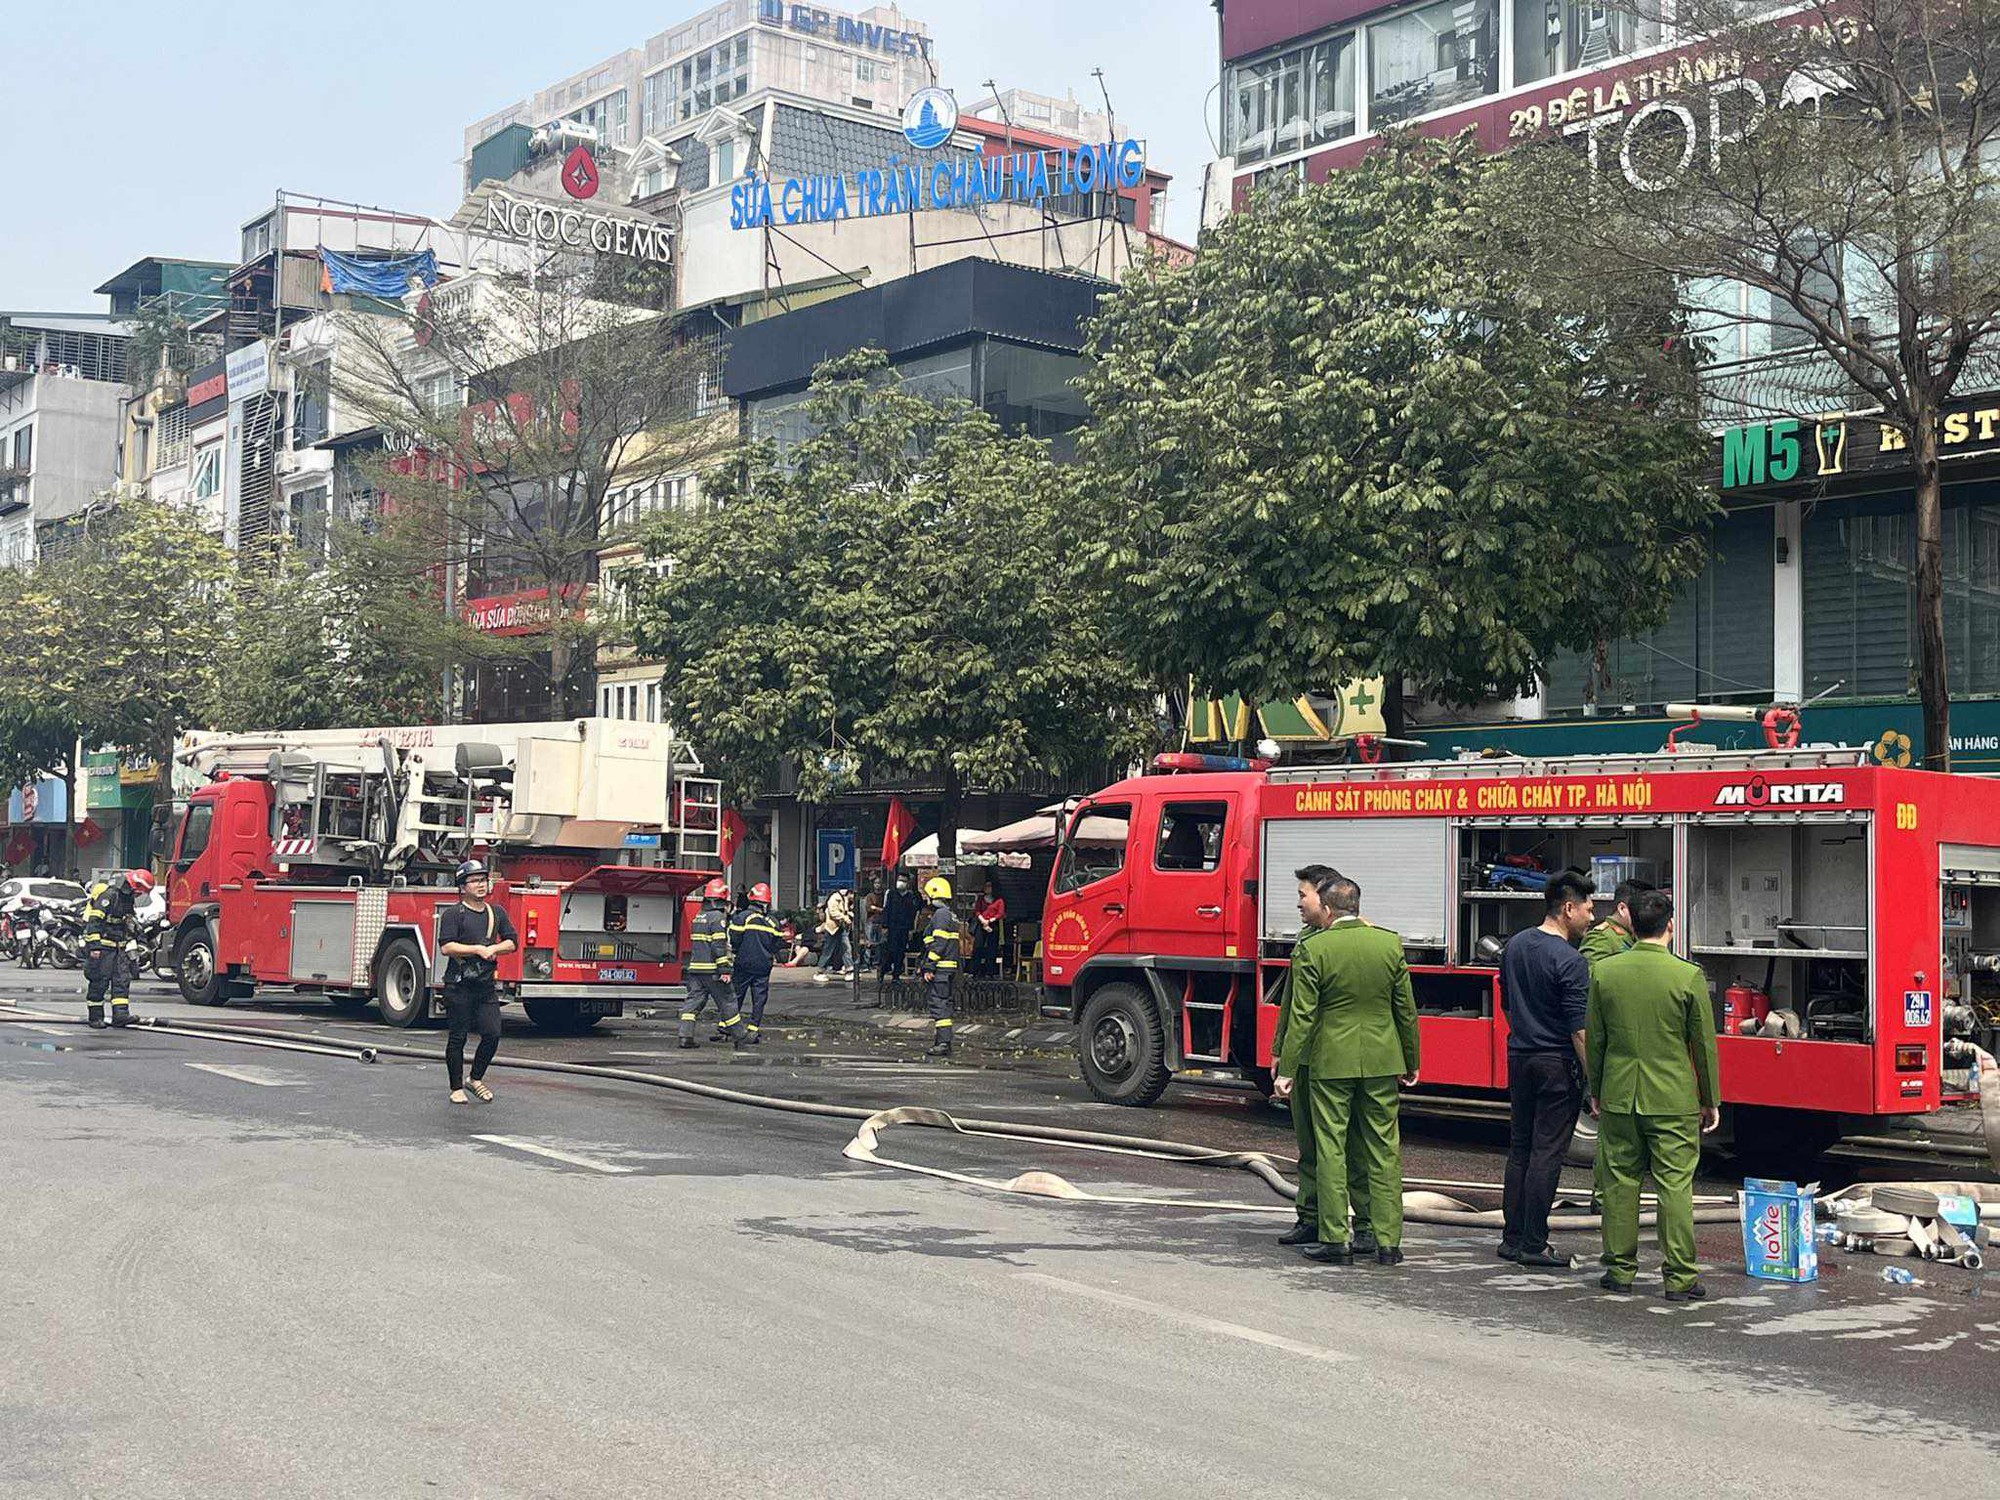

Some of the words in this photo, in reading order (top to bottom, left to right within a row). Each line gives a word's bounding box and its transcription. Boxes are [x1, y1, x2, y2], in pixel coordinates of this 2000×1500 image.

[791, 5, 831, 33] GP
[837, 16, 933, 57] INVEST
[1509, 106, 1543, 138] 29
[1593, 80, 1632, 114] LA
[730, 169, 775, 231] SỮA
[782, 172, 849, 226] CHUA
[930, 144, 1005, 211] CHÂU
[1061, 139, 1143, 197] LONG
[589, 217, 671, 263] GEMS
[1723, 419, 1800, 489] M5
[1964, 735, 1999, 750] HÀNG
[1296, 783, 1332, 812] CẢNH
[1335, 786, 1360, 812] SÁT
[1364, 784, 1411, 811] PHÒNG
[1415, 783, 1453, 810] CHÁY
[1457, 787, 1468, 809] &
[1477, 780, 1518, 809] CHỮA
[1522, 780, 1563, 808] CHÁY
[1567, 784, 1591, 807] TP.
[1596, 779, 1618, 806] HÀ
[1622, 777, 1651, 811] NỘI
[1714, 775, 1844, 806] MORITA
[828, 843, 845, 877] P
[1909, 992, 1926, 1010] 29A
